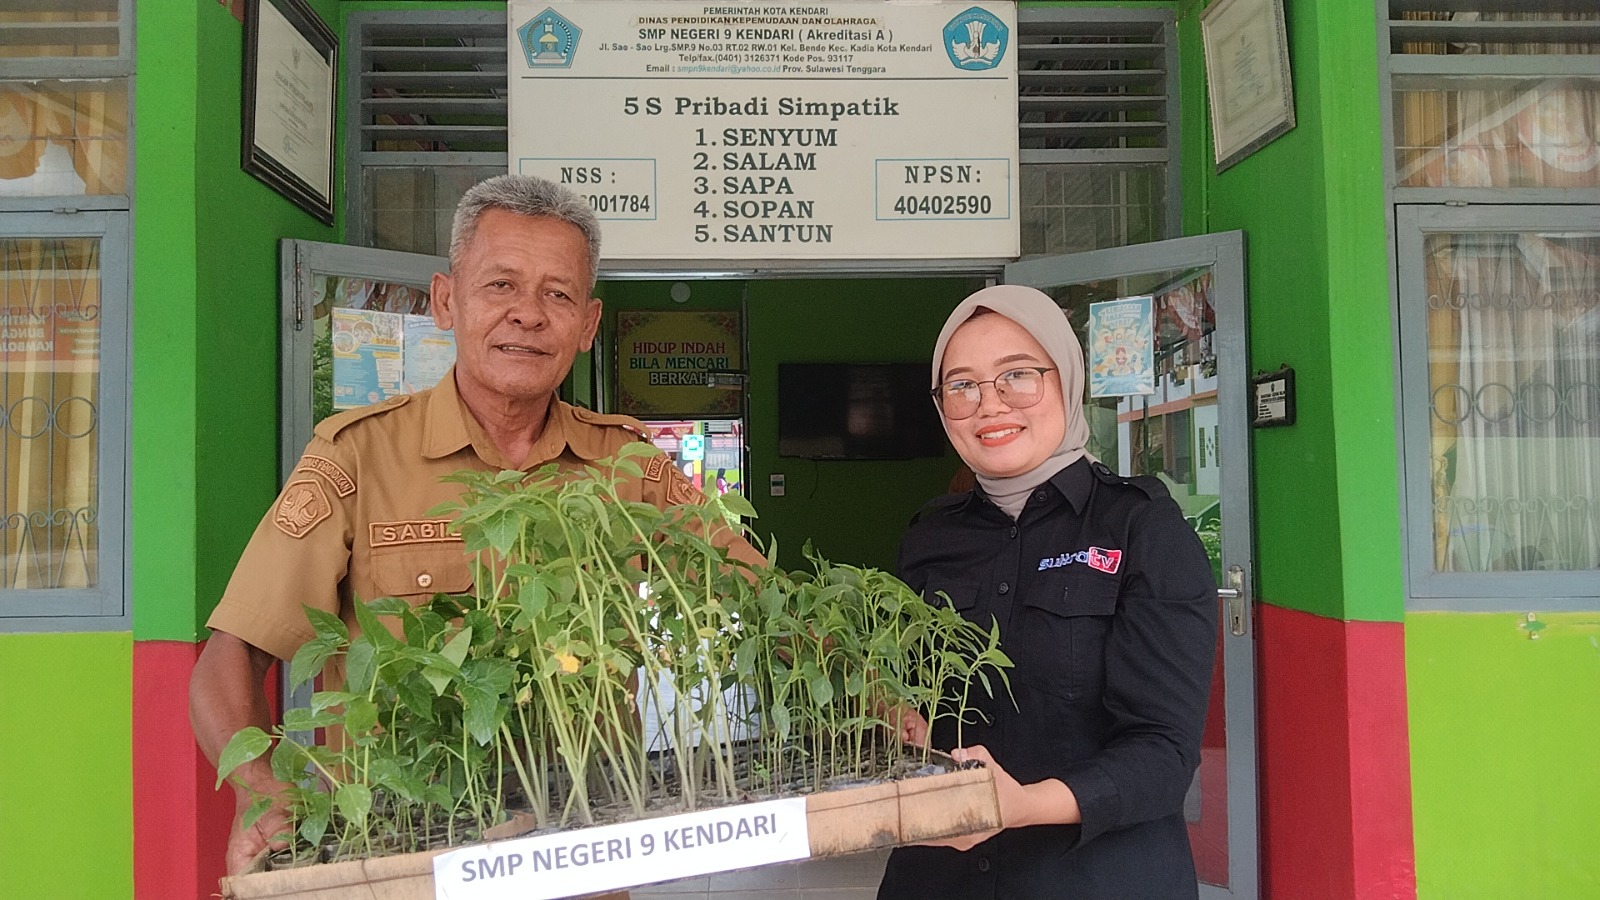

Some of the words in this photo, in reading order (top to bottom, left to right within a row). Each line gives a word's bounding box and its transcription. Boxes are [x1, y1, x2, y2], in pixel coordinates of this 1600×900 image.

[703, 7, 761, 15] PEMERINTAH
[763, 7, 787, 15] KOTA
[789, 7, 829, 16] KENDARI
[732, 17, 799, 25] KEPEMUDAAN
[802, 17, 822, 25] DAN
[638, 28, 666, 40] SMP
[671, 29, 720, 40] NEGERI
[724, 28, 732, 40] 9
[736, 29, 794, 40] KENDARI
[806, 29, 872, 41] Akreditasi
[875, 30, 885, 41] A
[599, 43, 609, 51] Jl.
[636, 43, 652, 51] Sao
[699, 43, 723, 52] No.03
[725, 43, 749, 52] RT.02
[751, 43, 777, 52] RW.01
[780, 44, 797, 52] Kel.
[800, 44, 826, 52] Bende
[828, 44, 847, 52] Kec.
[850, 44, 875, 52] Kadia
[877, 44, 897, 52] Kota
[899, 44, 933, 52] Kendari
[744, 54, 780, 63] 3126371
[783, 54, 804, 63] Kode
[807, 54, 825, 63] Pos.
[827, 54, 854, 63] 93117
[646, 64, 670, 73] Email
[782, 65, 803, 73] Prov.
[805, 65, 844, 73] Sulawesi
[846, 65, 886, 75] Tenggara
[675, 97, 769, 116] Pribadi
[778, 97, 900, 121] Simpatik
[722, 128, 838, 147] SENYUM
[722, 152, 817, 171] SALAM
[560, 167, 602, 184] NSS
[723, 176, 794, 195] SAPA
[723, 201, 815, 219] SOPAN
[894, 195, 992, 215] 40402590
[723, 225, 833, 243] SANTUN
[633, 342, 677, 354] HIDUP
[681, 342, 726, 354] INDAH
[629, 357, 660, 369] BILA
[665, 357, 729, 369] MENCARI
[315, 460, 352, 492] PENDIDIKAN
[461, 853, 523, 883] SMP
[533, 836, 631, 873] NEGERI
[640, 833, 656, 857] 9
[664, 812, 777, 853] KENDARI
